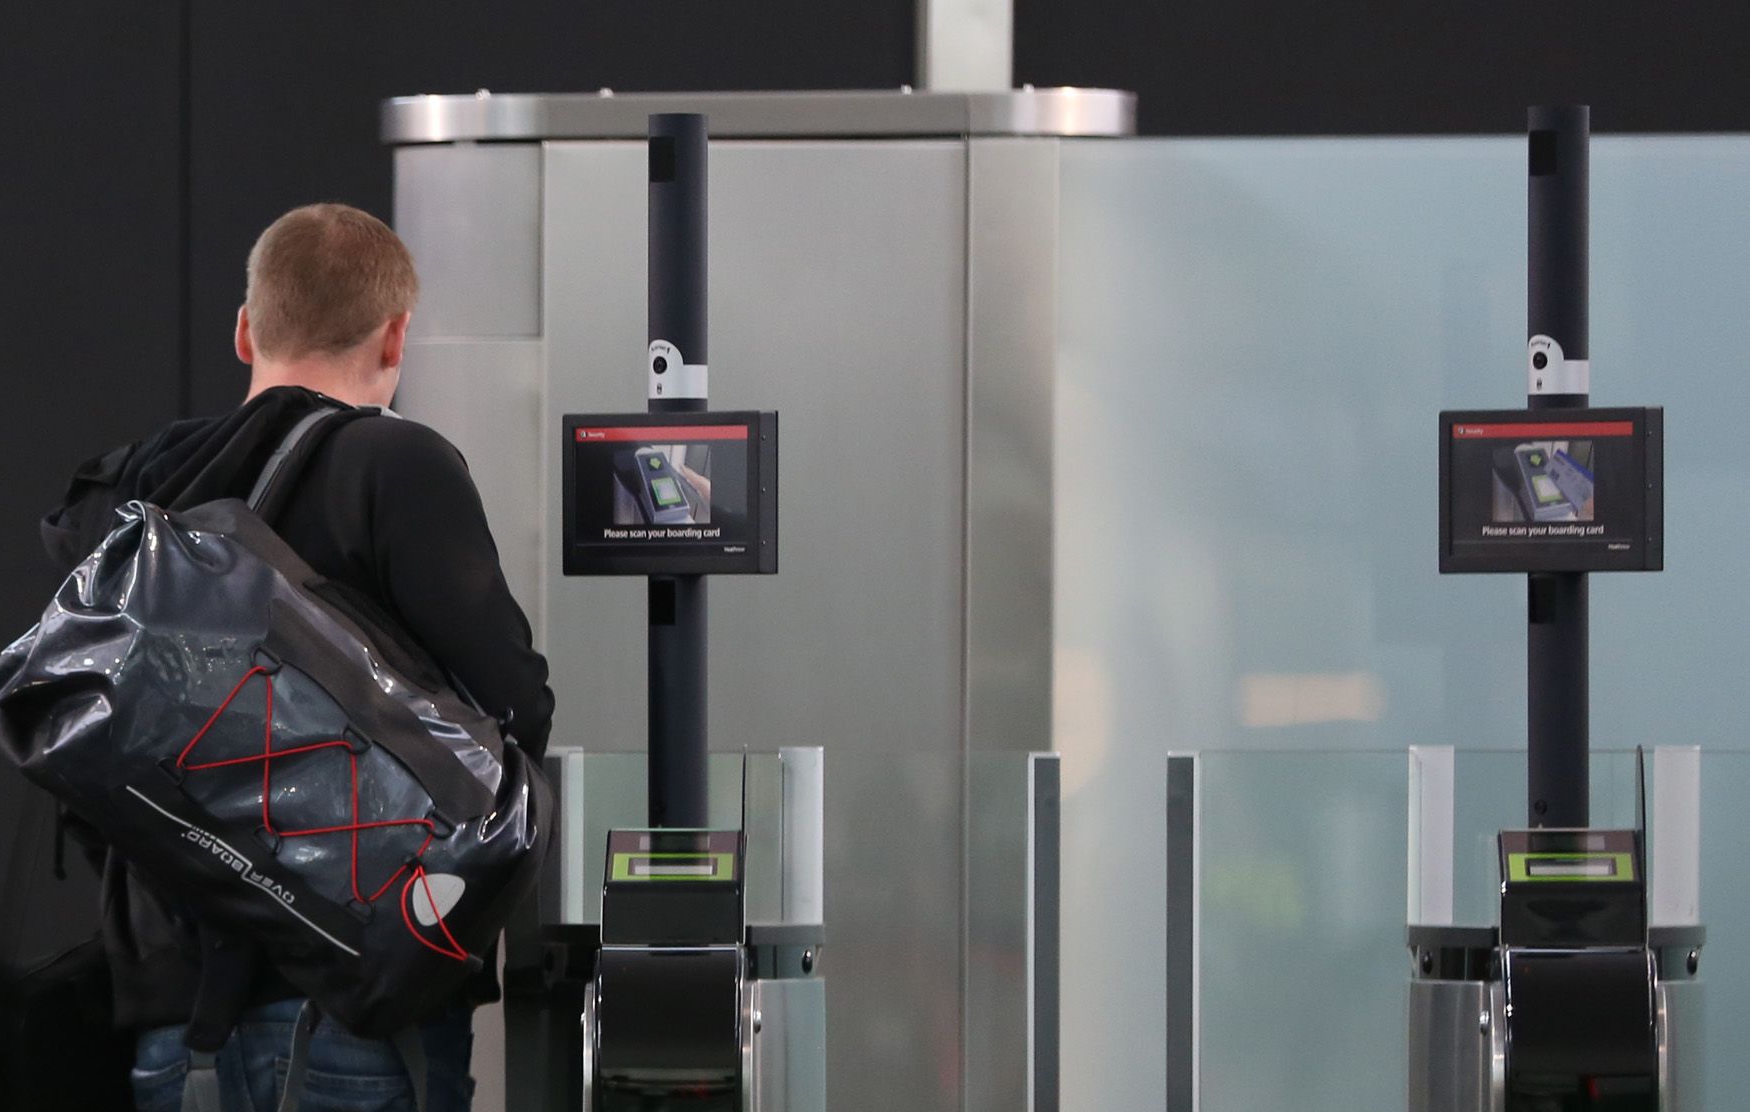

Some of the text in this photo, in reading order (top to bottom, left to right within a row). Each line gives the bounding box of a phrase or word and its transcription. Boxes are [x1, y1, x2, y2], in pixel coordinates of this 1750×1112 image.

[604, 530, 628, 538] Please
[648, 530, 666, 539] your
[667, 528, 702, 539] boarding
[703, 529, 720, 537] card
[1482, 527, 1507, 535] Please
[1528, 528, 1547, 536] your
[1548, 526, 1585, 536] boarding
[1586, 526, 1604, 534] card
